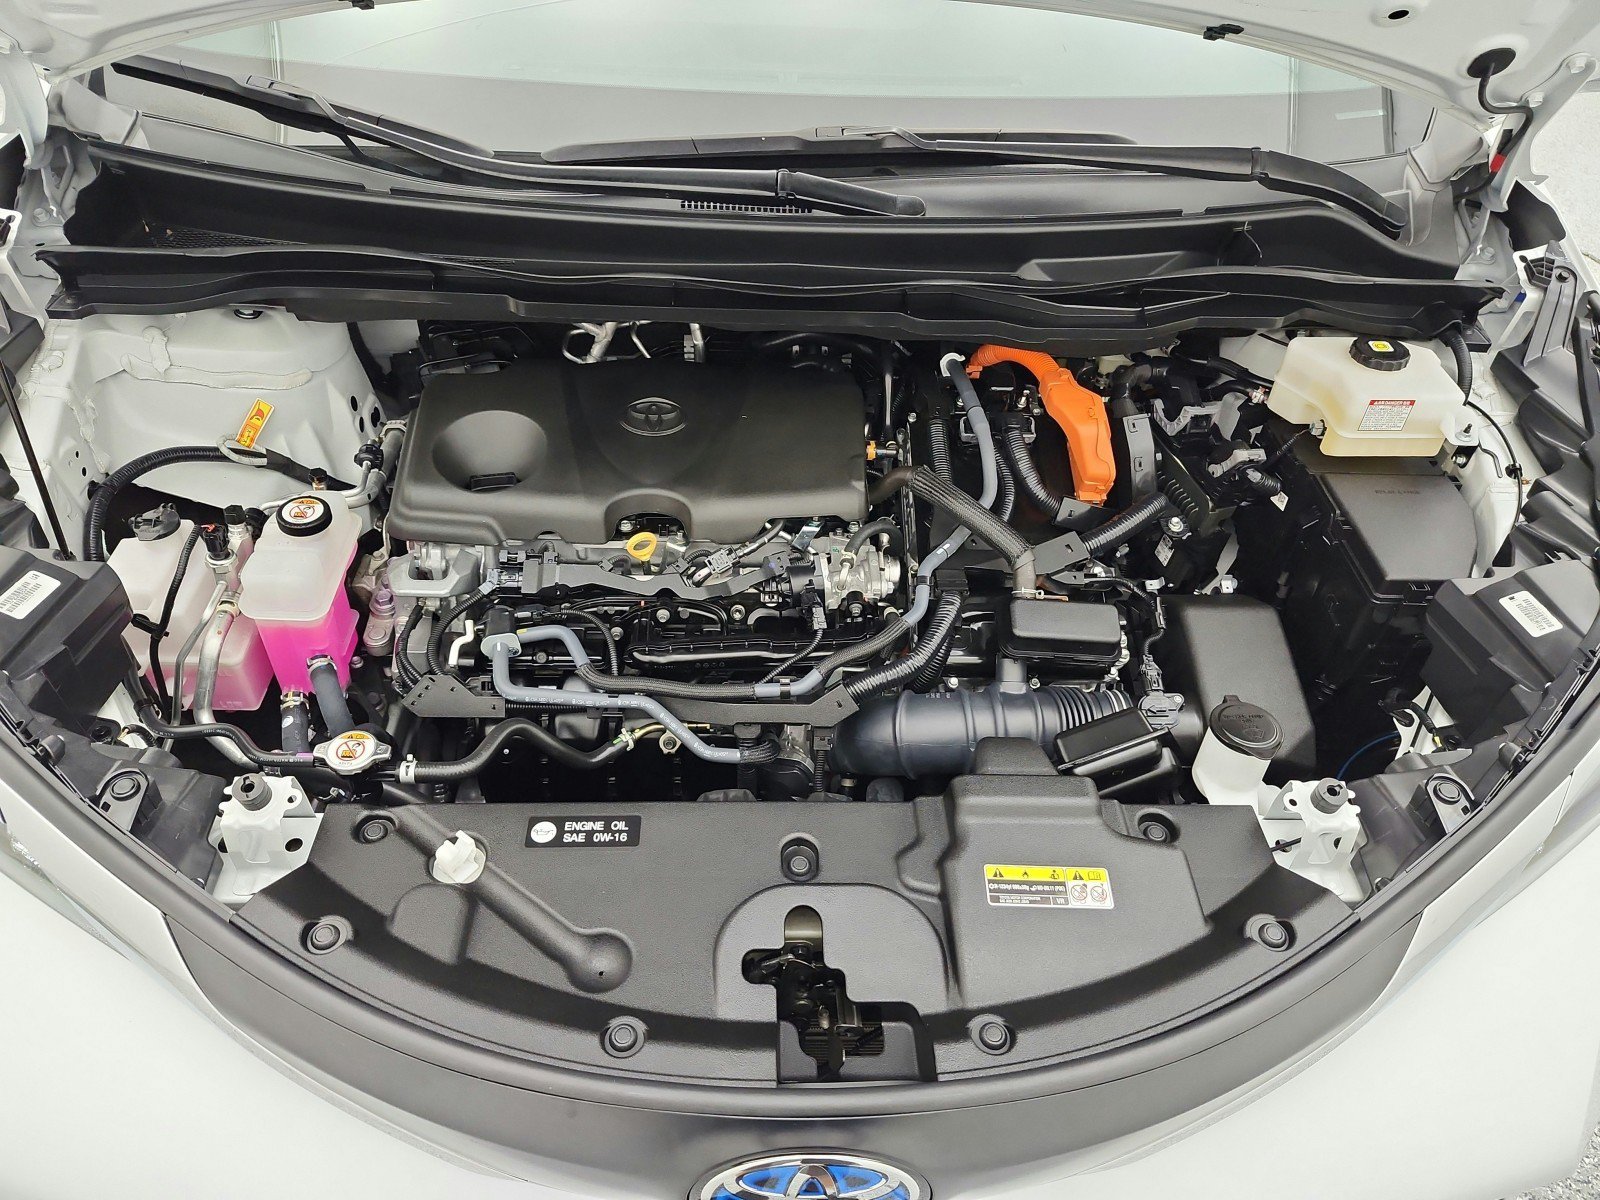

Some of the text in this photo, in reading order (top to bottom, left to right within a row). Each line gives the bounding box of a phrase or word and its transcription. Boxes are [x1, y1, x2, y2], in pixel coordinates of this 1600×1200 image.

[564, 821, 629, 831] ENGINE OIL
[563, 832, 628, 842] SAE 0W-16
